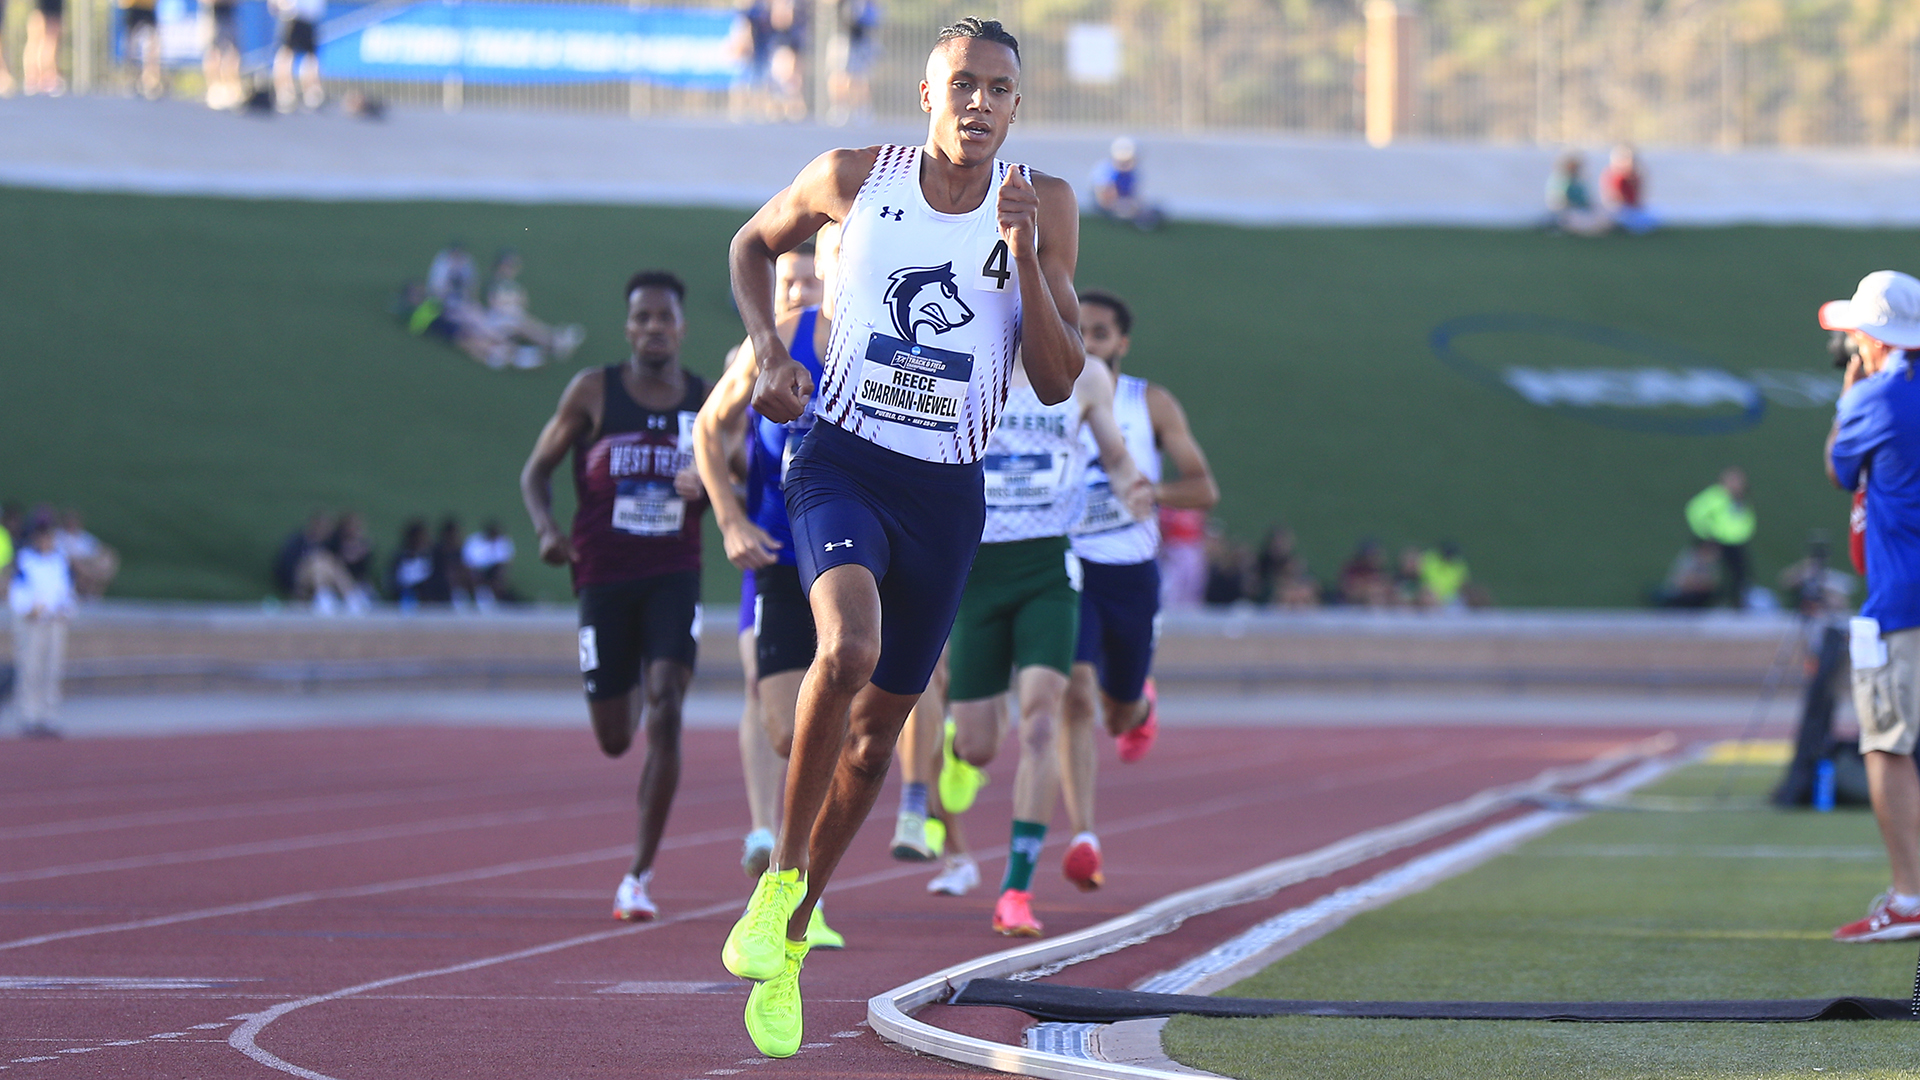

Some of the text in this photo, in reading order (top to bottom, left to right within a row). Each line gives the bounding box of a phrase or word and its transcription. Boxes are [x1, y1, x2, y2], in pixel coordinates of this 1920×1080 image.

[982, 239, 1012, 290] 4
[892, 370, 937, 392] REECE
[861, 379, 958, 417] SHARMAN-NEWELL
[610, 444, 651, 477] WEST
[1058, 453, 1069, 485] 7
